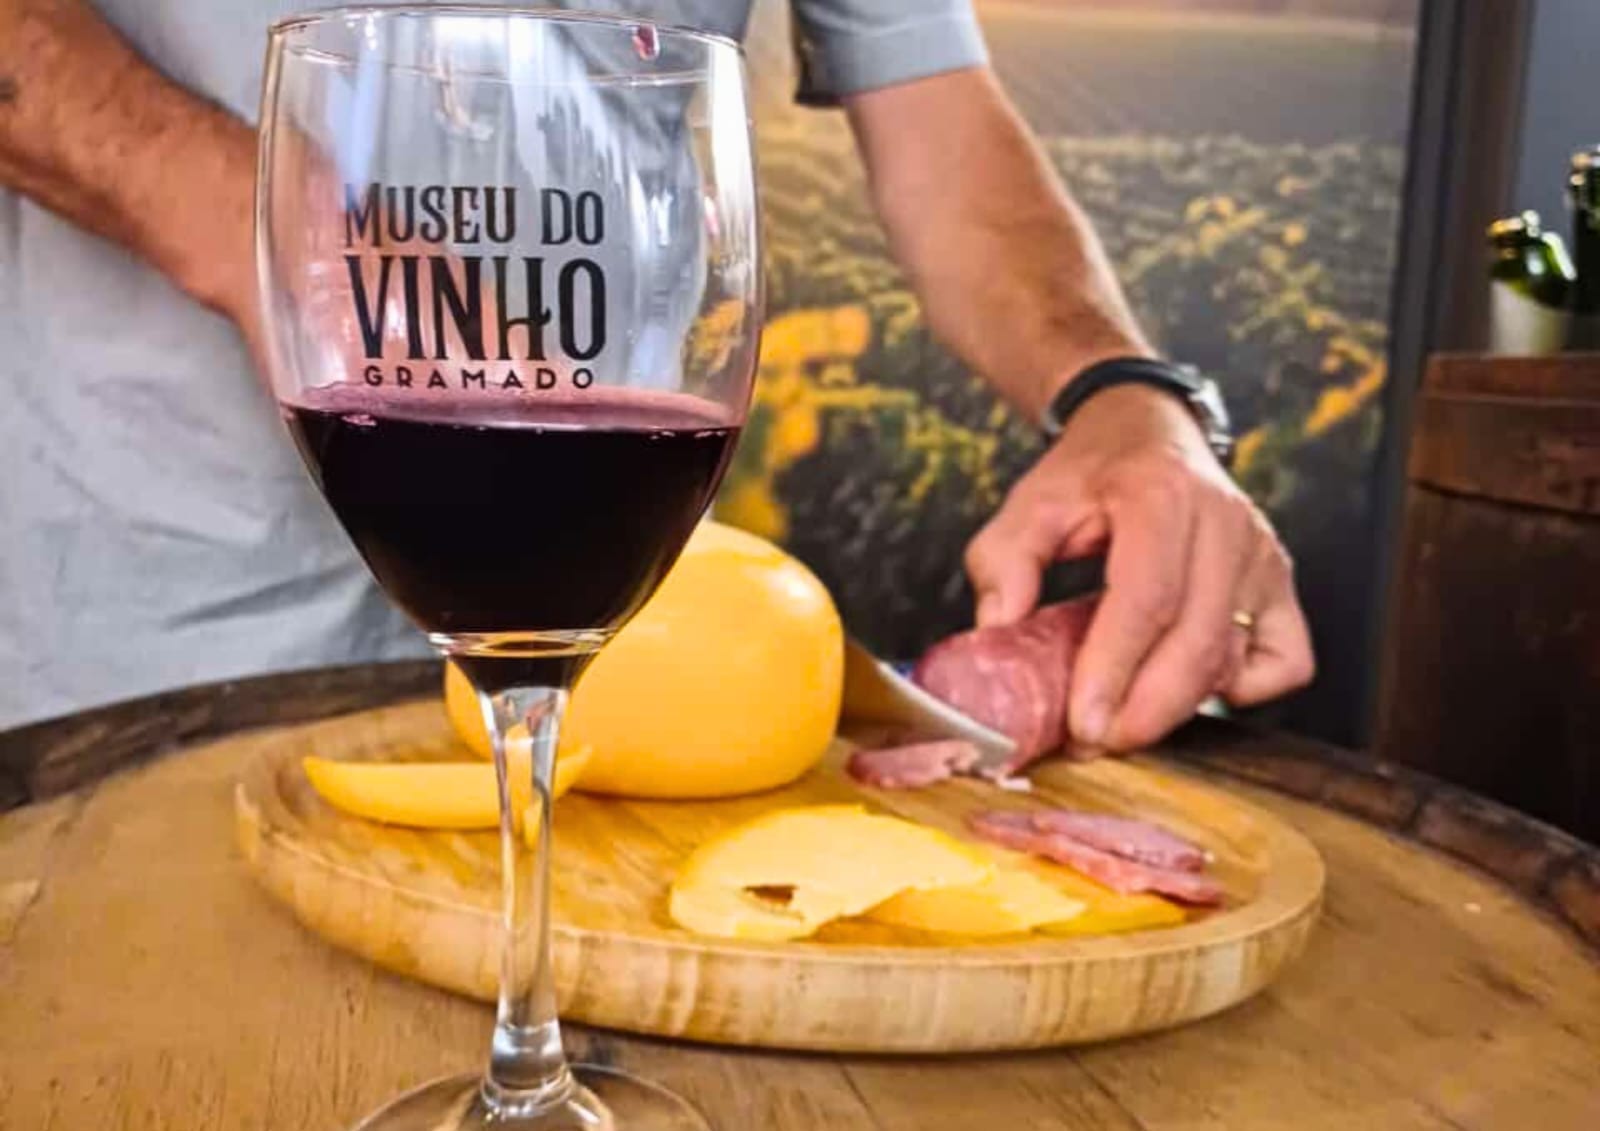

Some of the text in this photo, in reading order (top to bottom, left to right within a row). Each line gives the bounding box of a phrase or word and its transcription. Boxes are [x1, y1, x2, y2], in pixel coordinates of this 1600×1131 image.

[345, 182, 605, 248] MUSEU DO
[344, 255, 606, 361] VINHO
[364, 365, 593, 389] GRAMADO
